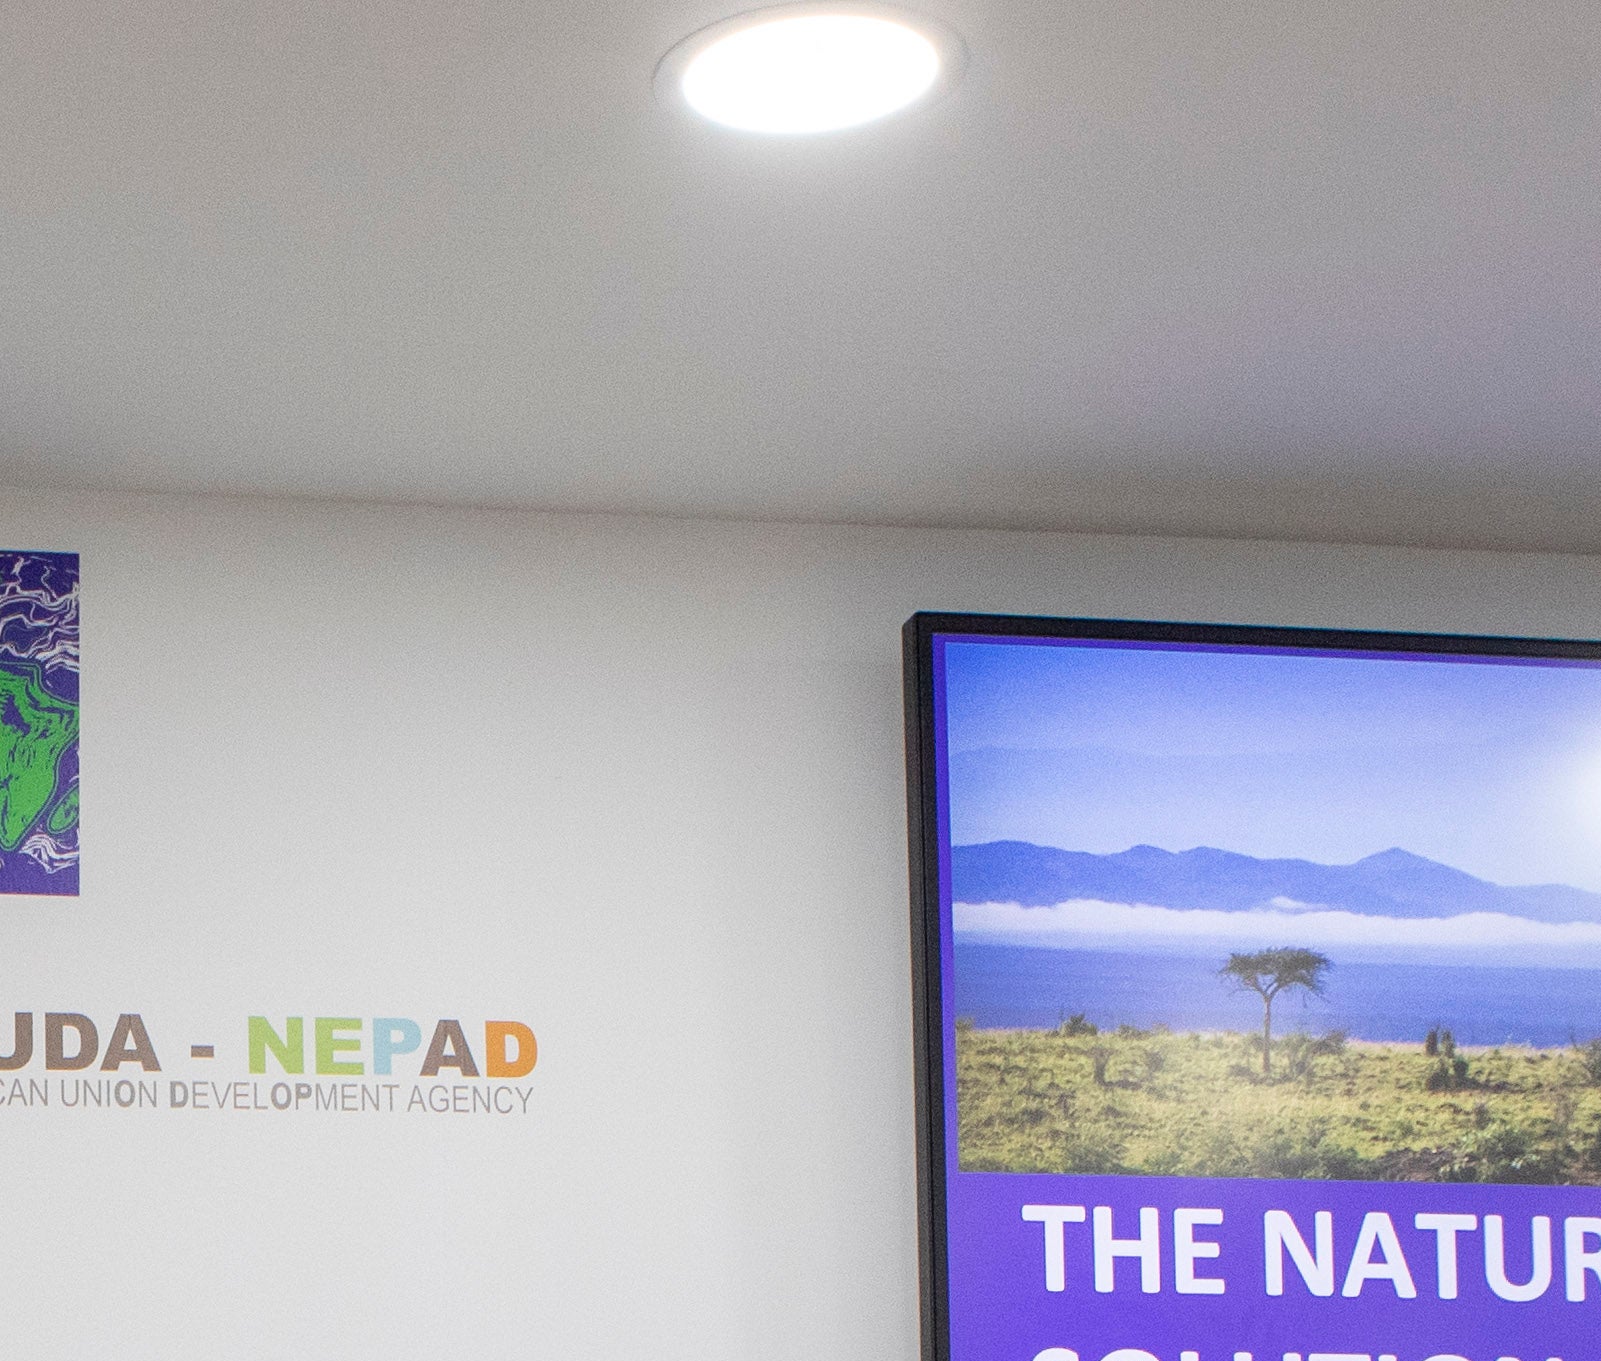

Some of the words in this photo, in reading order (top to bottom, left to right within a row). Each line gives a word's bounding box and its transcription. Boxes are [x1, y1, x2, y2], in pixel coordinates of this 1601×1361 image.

[247, 1014, 539, 1078] NEPAD
[61, 1078, 158, 1109] UNION
[169, 1080, 402, 1112] DEVELOPMENT
[406, 1084, 534, 1115] AGENCY
[1021, 1204, 1226, 1296] THE
